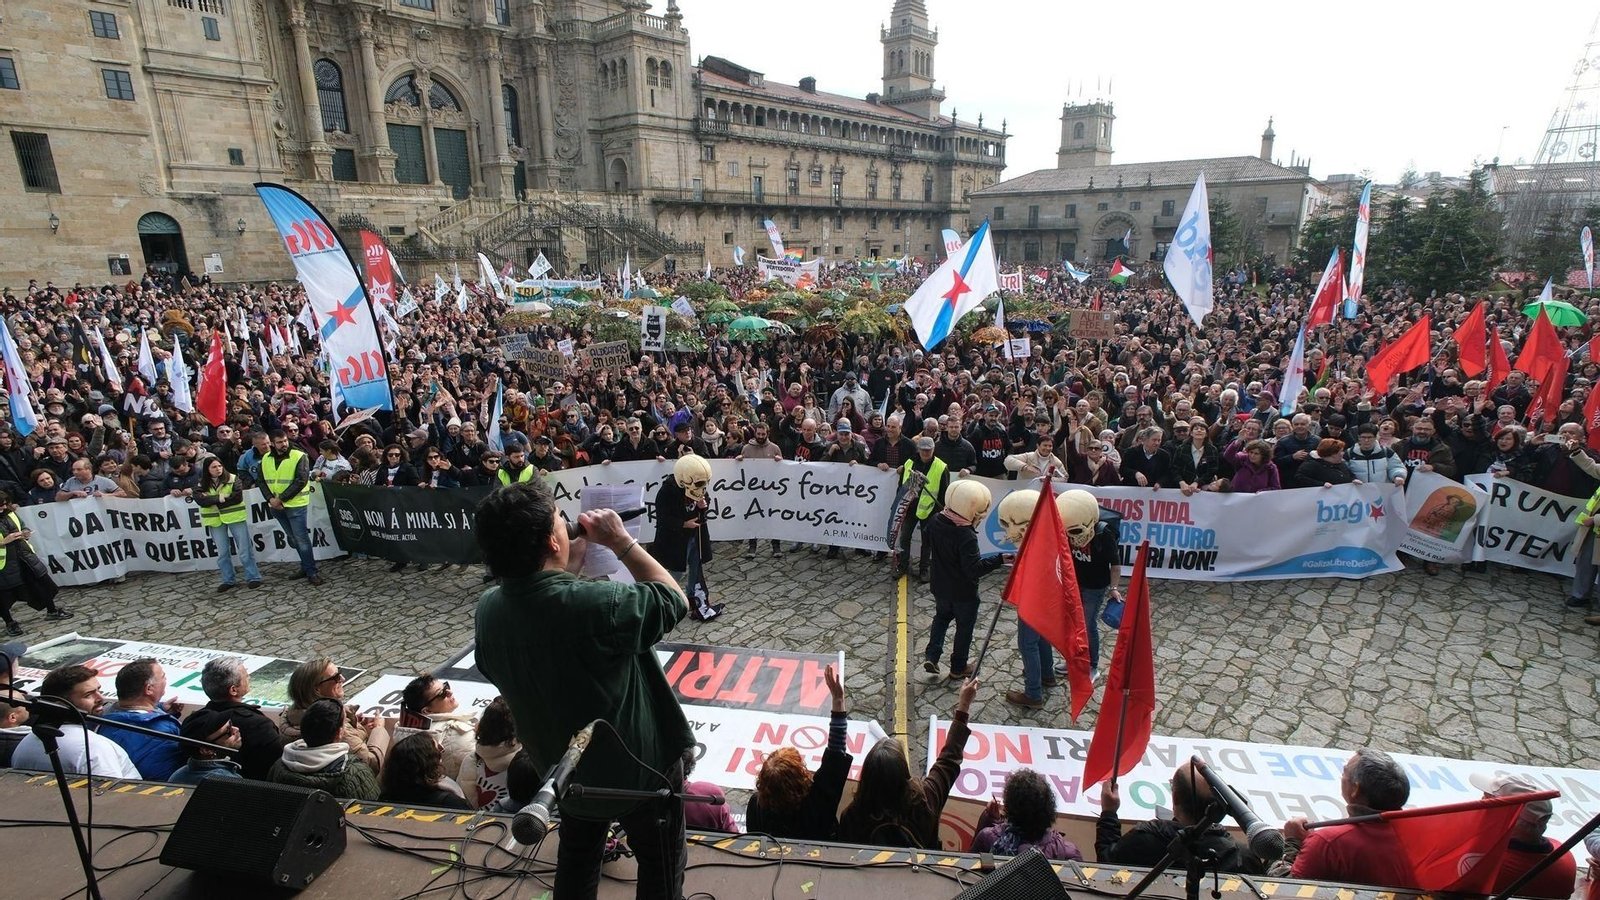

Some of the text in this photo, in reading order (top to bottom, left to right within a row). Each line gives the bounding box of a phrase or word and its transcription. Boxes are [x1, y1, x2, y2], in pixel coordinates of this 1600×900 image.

[1000, 274, 1020, 289] LTRI
[590, 343, 627, 357] ALDEANAS
[593, 357, 605, 368] EN
[713, 469, 878, 503] adeus fontes
[106, 509, 181, 532] TERRA
[363, 510, 386, 528] NON
[391, 507, 400, 530] Á
[406, 511, 443, 529] MINA.
[445, 512, 457, 529] SI
[744, 497, 868, 527] Arousa....
[1149, 500, 1195, 526] VIDA.
[1317, 499, 1363, 524] bng
[823, 529, 851, 539] A.P.M.
[853, 531, 887, 543] Viladom
[1146, 523, 1219, 550] FUTURO.
[48, 554, 66, 575] A
[64, 539, 138, 573] XUNTA
[1168, 549, 1218, 572] NON!
[666, 650, 839, 709] ALTRI
